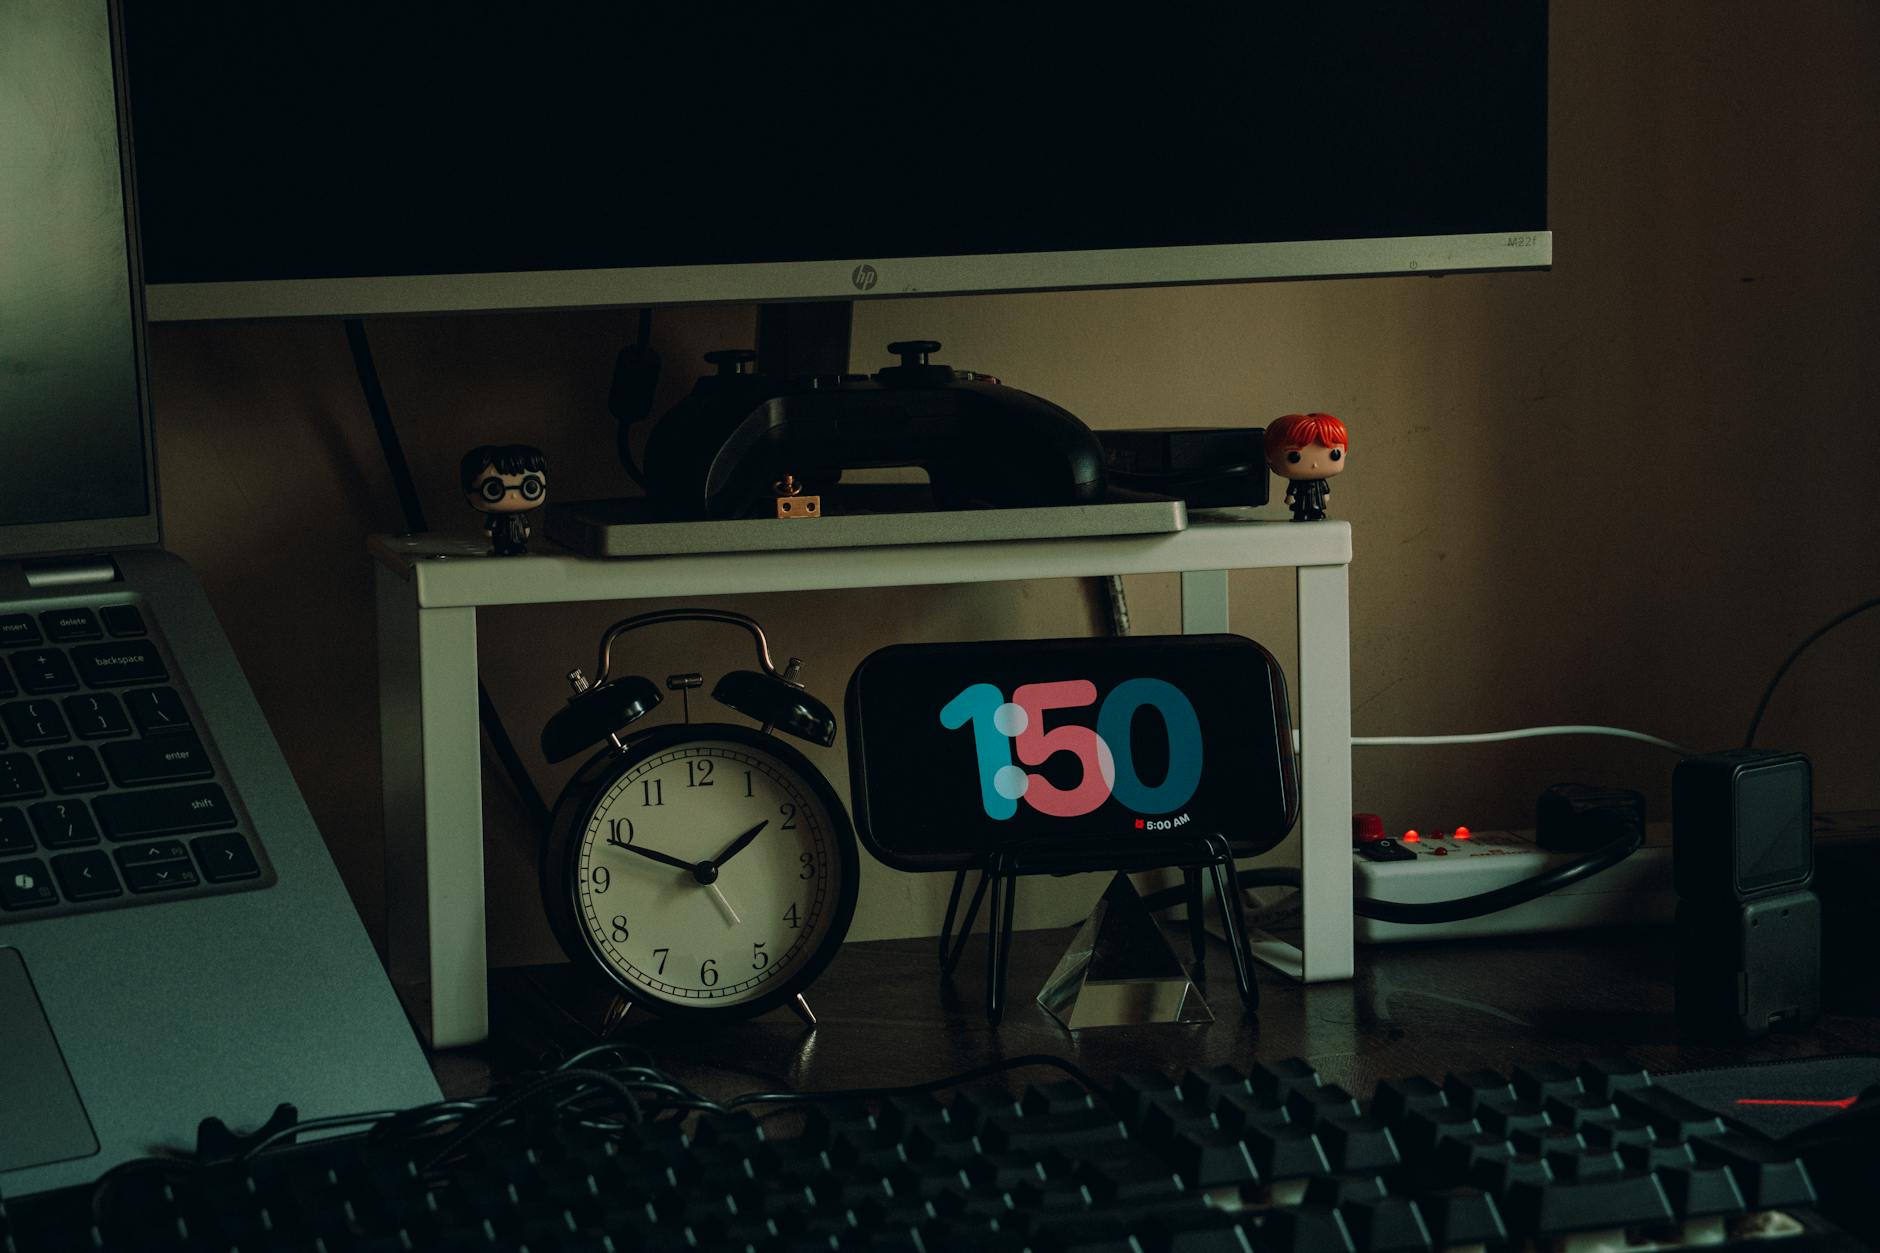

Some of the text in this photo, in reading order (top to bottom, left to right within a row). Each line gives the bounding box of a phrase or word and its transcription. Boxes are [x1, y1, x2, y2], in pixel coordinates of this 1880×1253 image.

[852, 264, 877, 290] hp
[60, 617, 87, 627] delete
[95, 655, 144, 667] backspace
[165, 751, 190, 761] enter
[939, 677, 1203, 821] 1:50
[686, 759, 714, 787] 12
[744, 771, 755, 798] 1
[191, 798, 215, 809] shift
[641, 779, 664, 806] 11
[779, 803, 796, 830] 2
[1146, 813, 1190, 831] 5:00 AM
[607, 817, 634, 846] 10
[800, 852, 815, 880] 3
[592, 866, 610, 894] 9
[611, 915, 629, 943] 8
[782, 902, 801, 929] 4
[653, 948, 669, 975] 7
[752, 942, 769, 970] 5
[700, 959, 718, 987] 6
